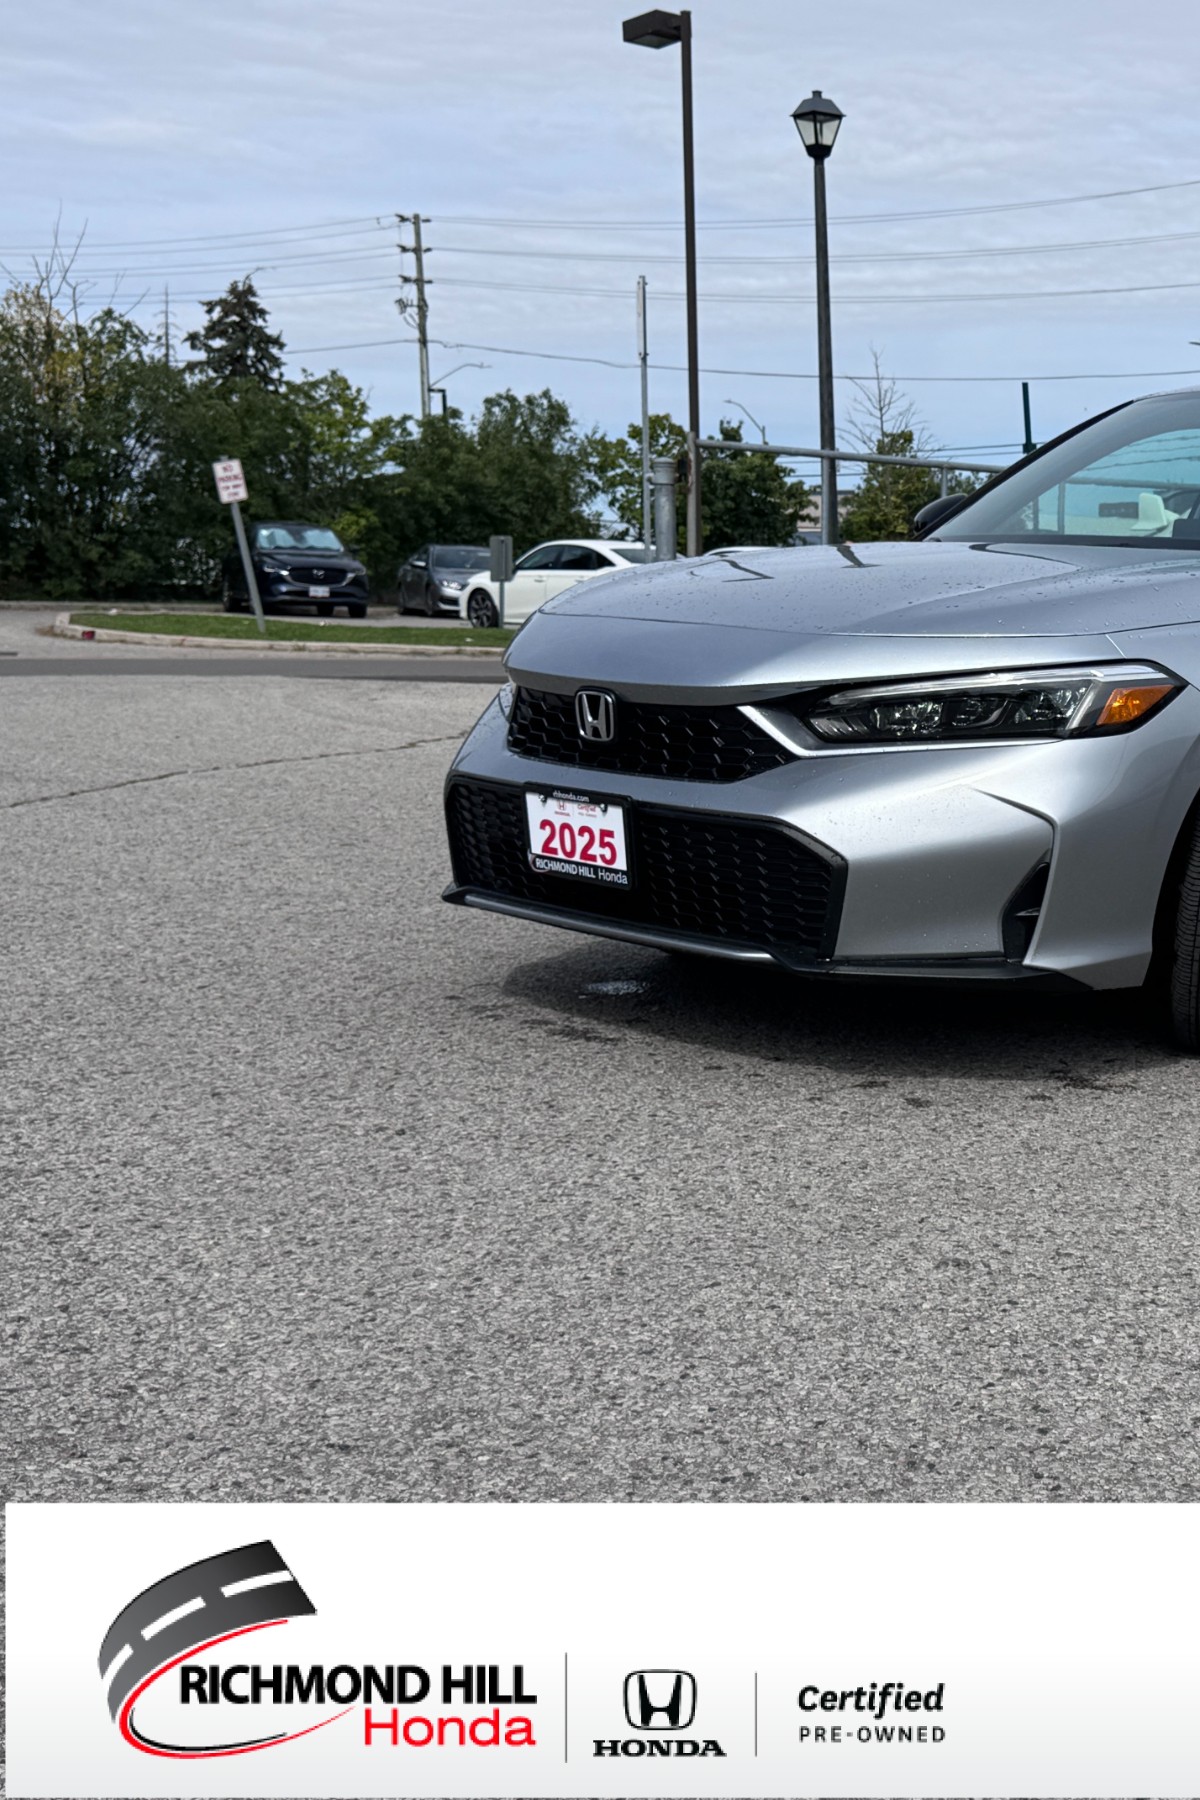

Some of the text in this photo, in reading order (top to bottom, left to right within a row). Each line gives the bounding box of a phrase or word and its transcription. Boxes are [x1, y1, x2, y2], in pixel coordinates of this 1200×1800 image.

[539, 818, 617, 866] 2025
[535, 857, 628, 884] RICHMOND HILL Honda
